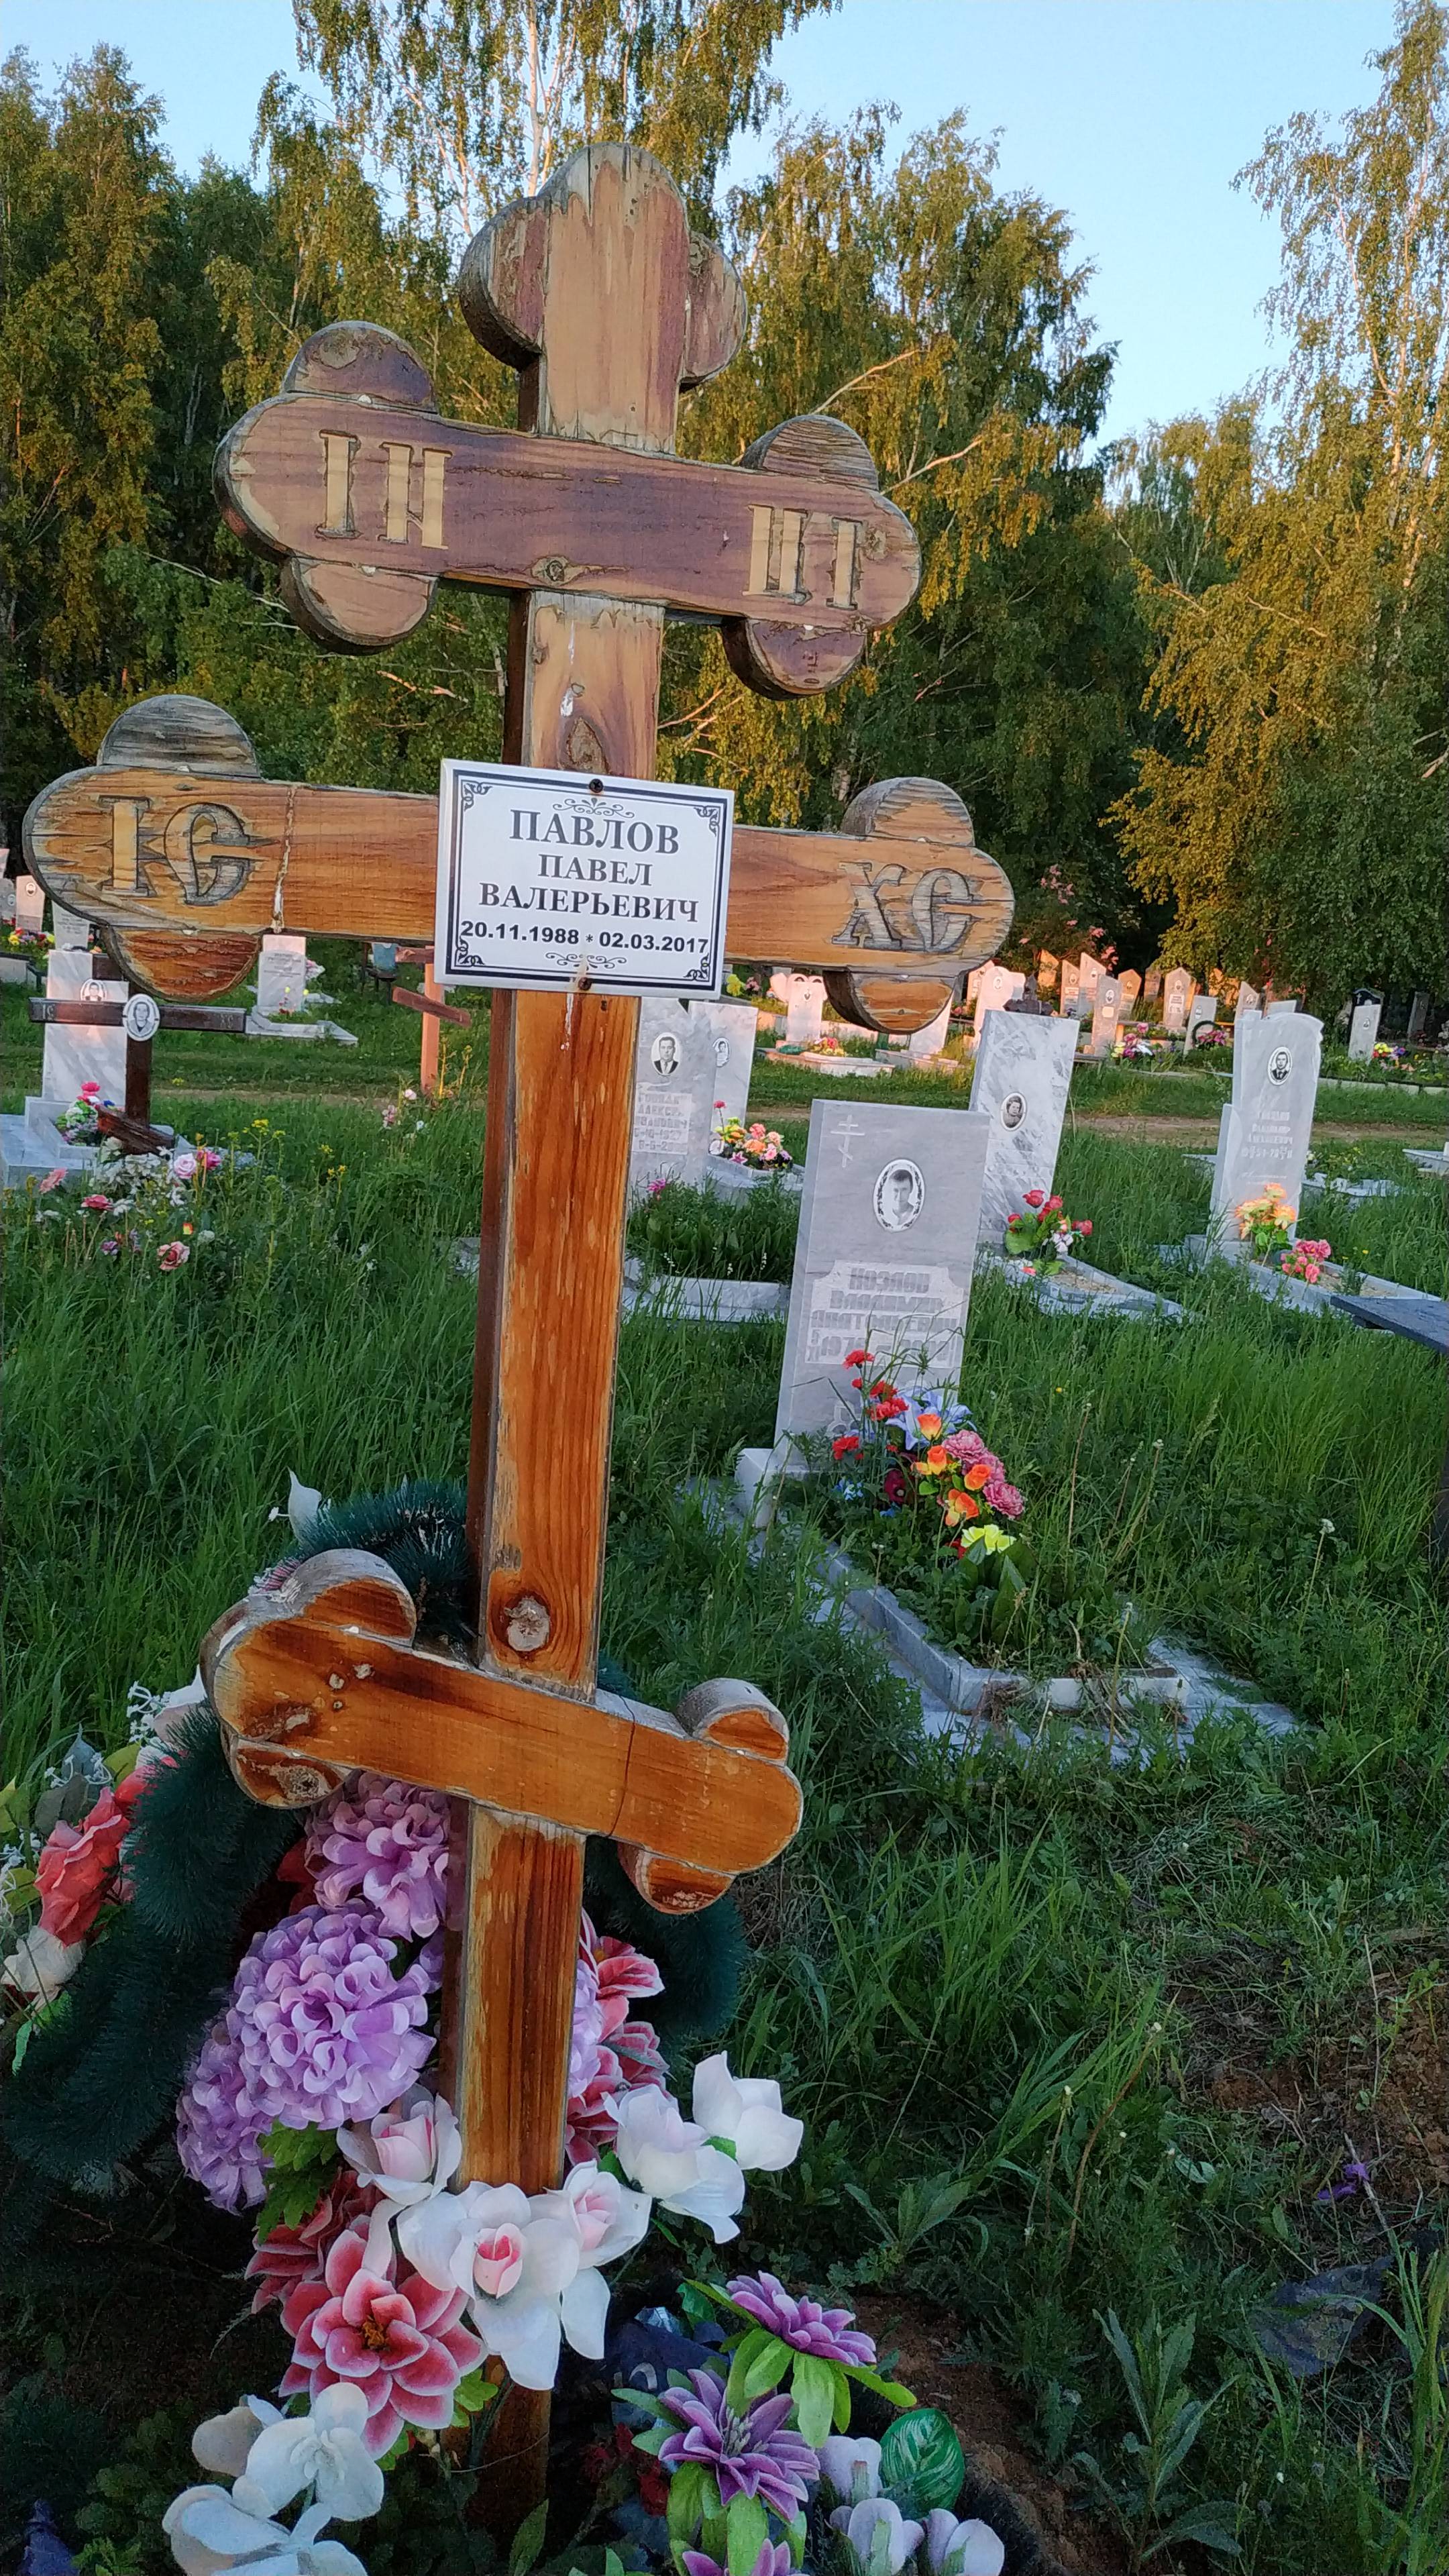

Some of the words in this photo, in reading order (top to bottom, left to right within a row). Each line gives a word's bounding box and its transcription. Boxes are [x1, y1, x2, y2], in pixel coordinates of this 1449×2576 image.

[508, 809, 680, 855] ПАВЛОВ
[537, 854, 653, 886] ПАВЕЛ
[478, 882, 699, 923] ВАЛЕРЬЕВИЧ
[460, 920, 580, 945] 20.11.1988
[598, 931, 709, 954] 02.03.2017
